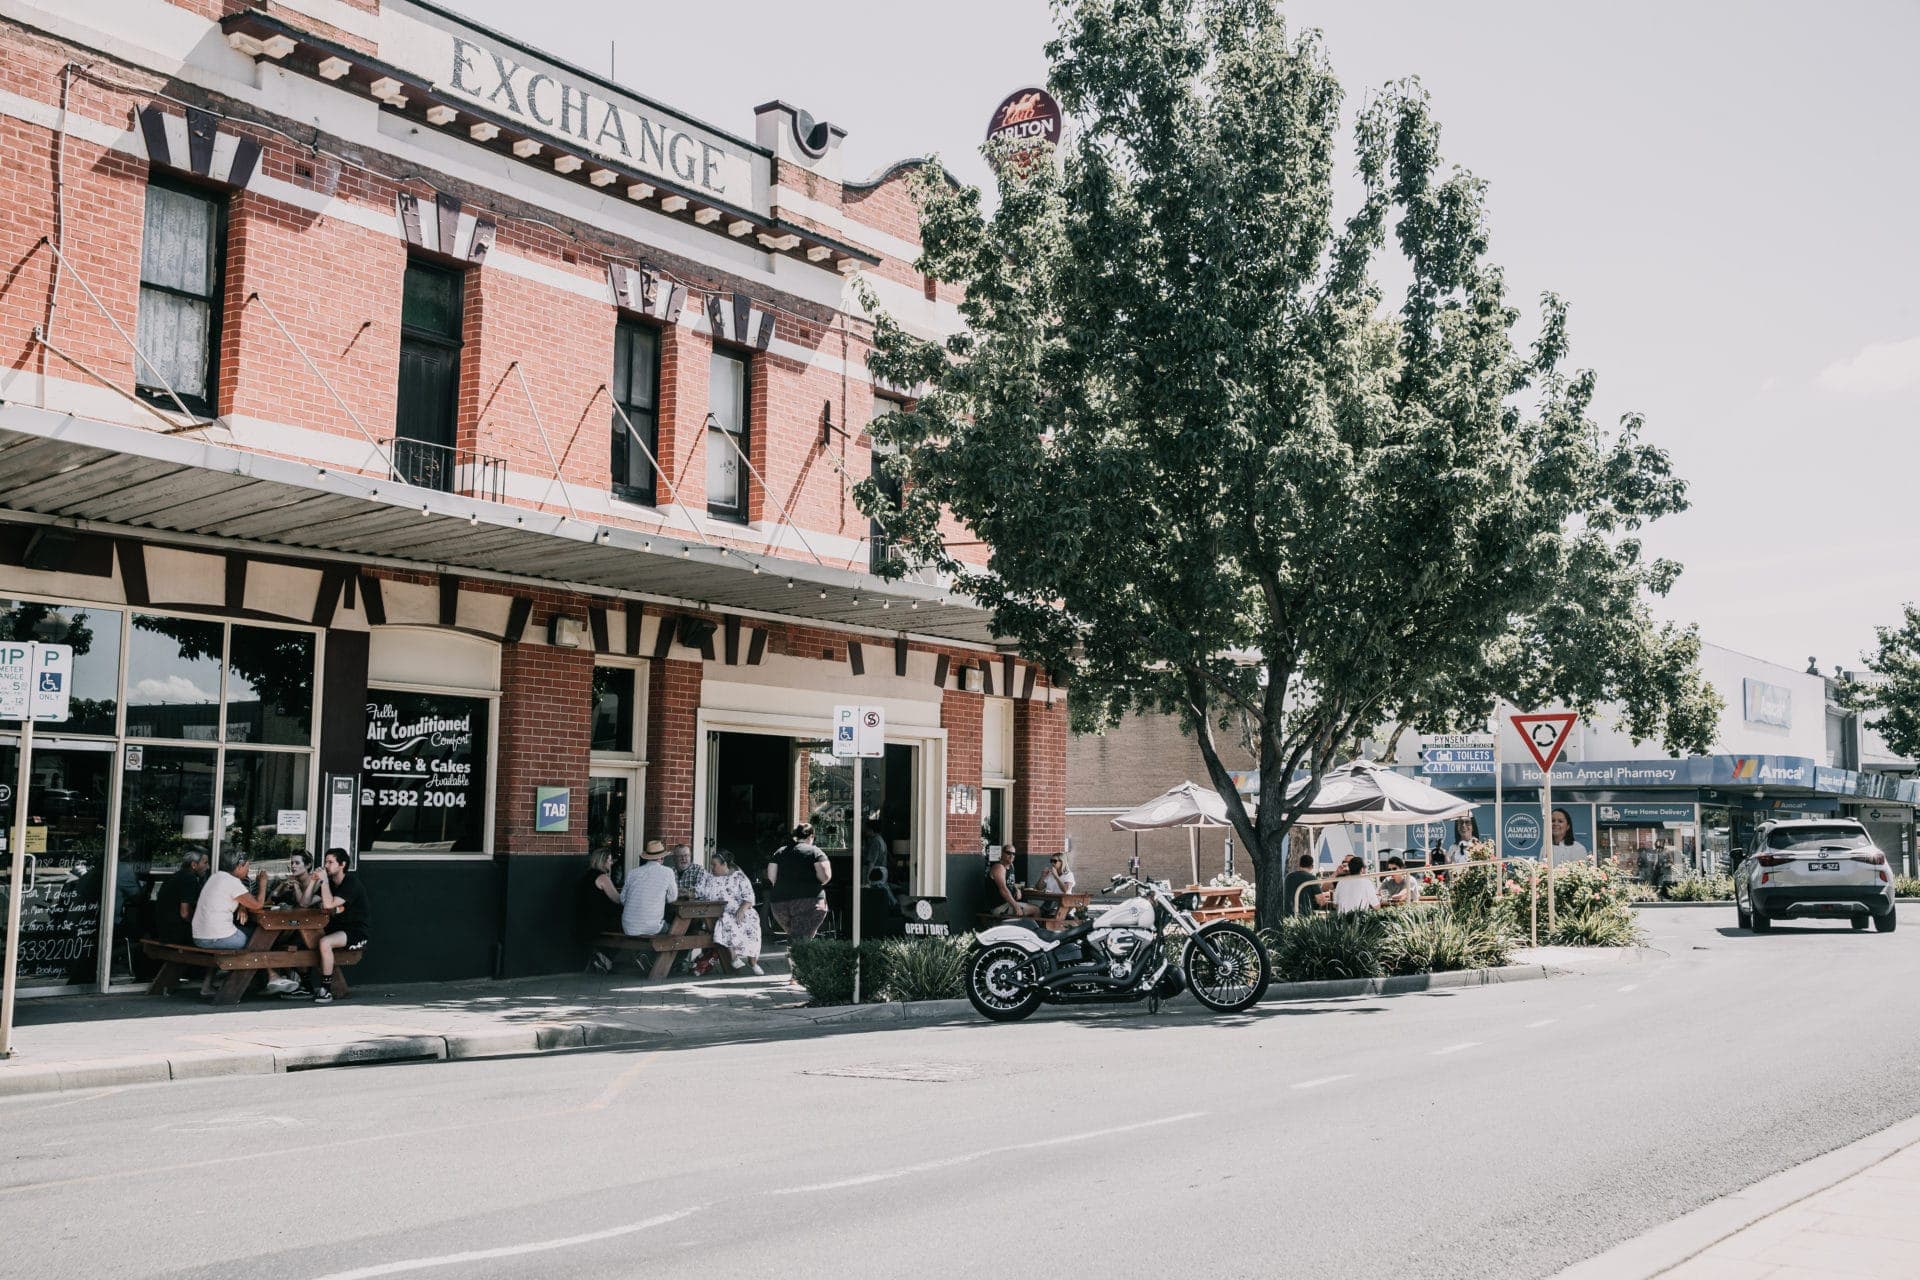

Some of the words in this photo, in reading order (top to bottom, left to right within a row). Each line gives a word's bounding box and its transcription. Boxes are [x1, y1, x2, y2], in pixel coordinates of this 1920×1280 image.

[450, 36, 726, 194] EXCHANGE
[0, 648, 24, 665] 1P
[45, 650, 59, 667] P
[366, 703, 399, 722] Fully
[841, 710, 851, 723] P
[367, 721, 388, 740] Air
[391, 713, 470, 740] Conditioned
[431, 731, 473, 752] Comfort
[1434, 735, 1469, 744] PYNSENT
[1456, 750, 1490, 761] TOILETS
[363, 755, 411, 771] Coffee
[415, 758, 427, 772] &
[430, 759, 472, 774] Cakes
[1433, 763, 1442, 772] AT
[1447, 763, 1467, 772] TOWN
[1470, 762, 1490, 772] HALL
[425, 773, 470, 788] Available
[1522, 769, 1573, 780] Horham
[1576, 768, 1613, 779] Amcal
[1617, 767, 1677, 781] Pharmacy
[379, 789, 418, 806] 5382
[423, 790, 467, 808] 2004
[543, 803, 566, 817] TAB
[43, 883, 52, 901] 7
[905, 922, 924, 935] OPEN
[930, 924, 949, 936] DAYS
[17, 937, 95, 961] 53822004
